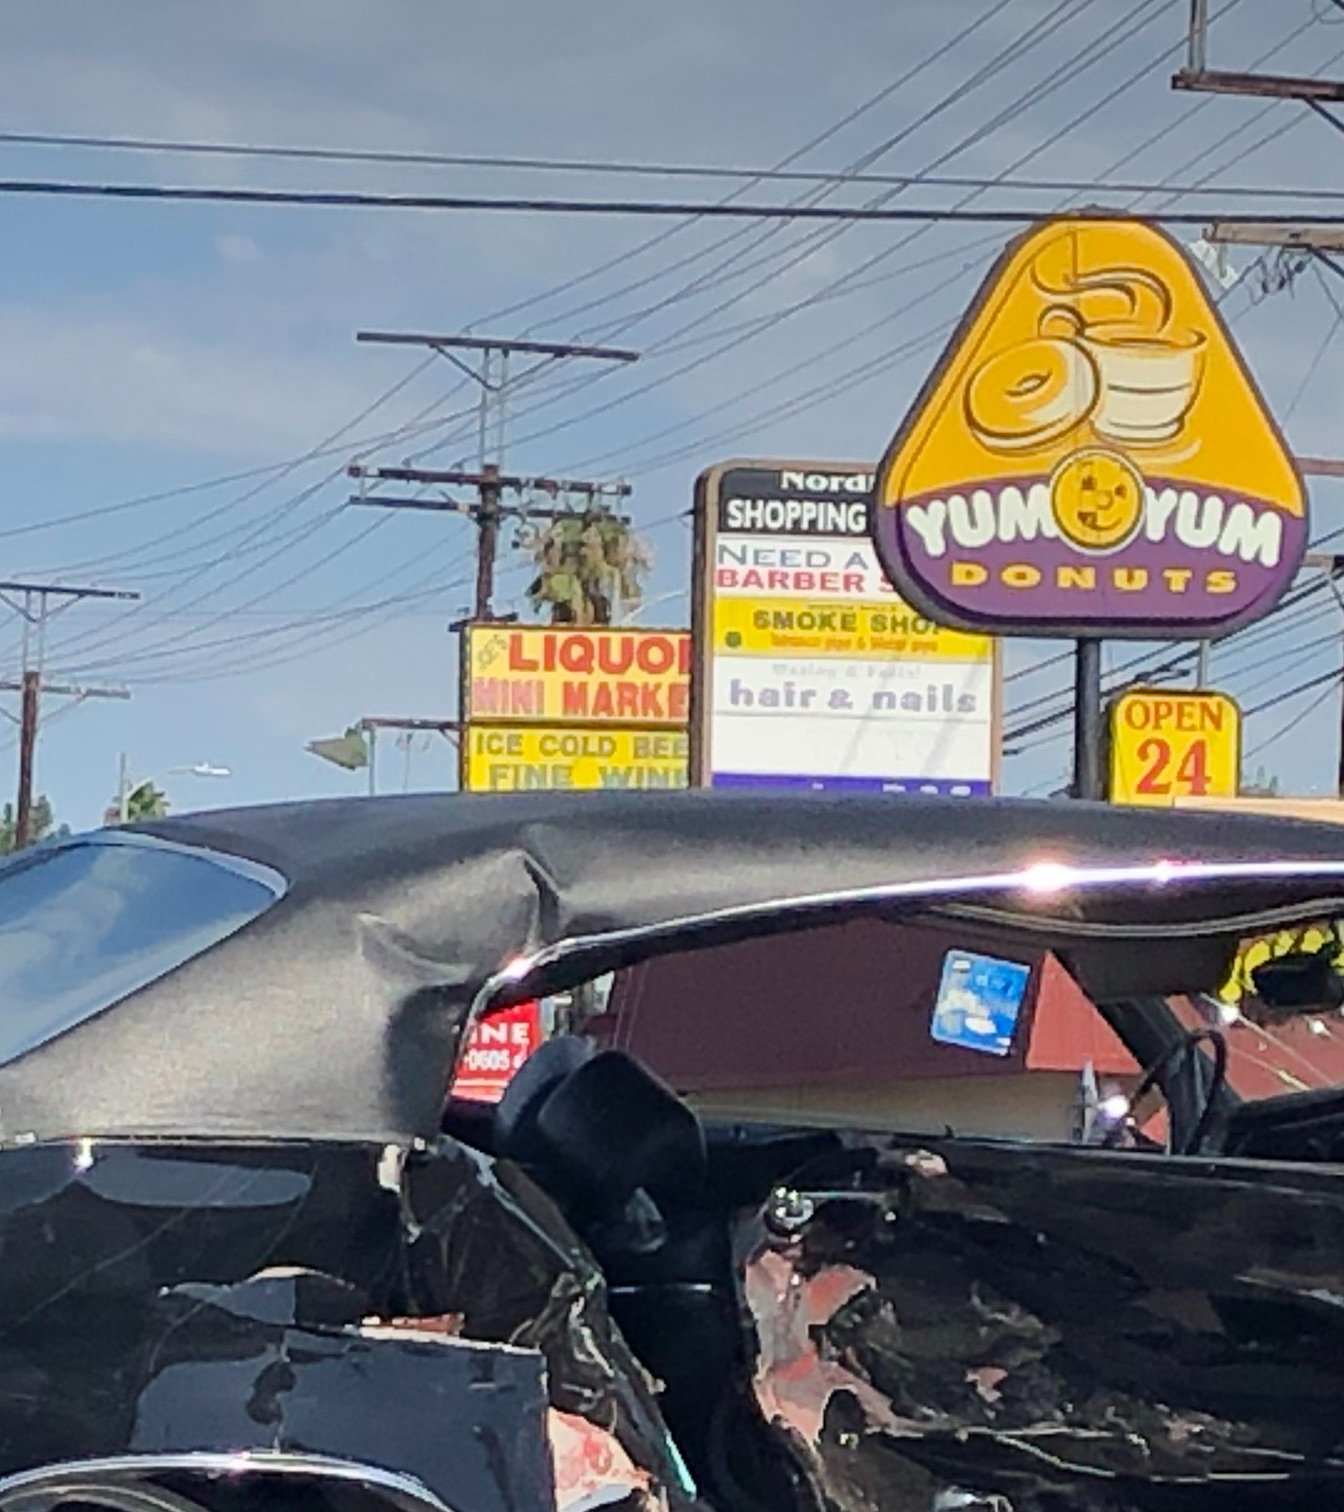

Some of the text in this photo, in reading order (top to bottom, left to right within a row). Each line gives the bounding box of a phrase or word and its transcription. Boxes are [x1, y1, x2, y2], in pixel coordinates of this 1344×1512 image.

[727, 499, 867, 532] SHOPPING
[906, 483, 1283, 569] YUM YUM
[717, 544, 870, 571] NEED A
[716, 568, 866, 593] BARBER
[951, 560, 1238, 594] DONUTS
[752, 609, 940, 635] SMOKE SHO
[472, 677, 545, 716] MINI
[730, 679, 977, 713] hair & nails
[1124, 699, 1224, 732] OPEN
[476, 732, 523, 756] ICE
[538, 734, 617, 758] COLD
[488, 763, 573, 790] FINE
[1135, 737, 1212, 796] 24
